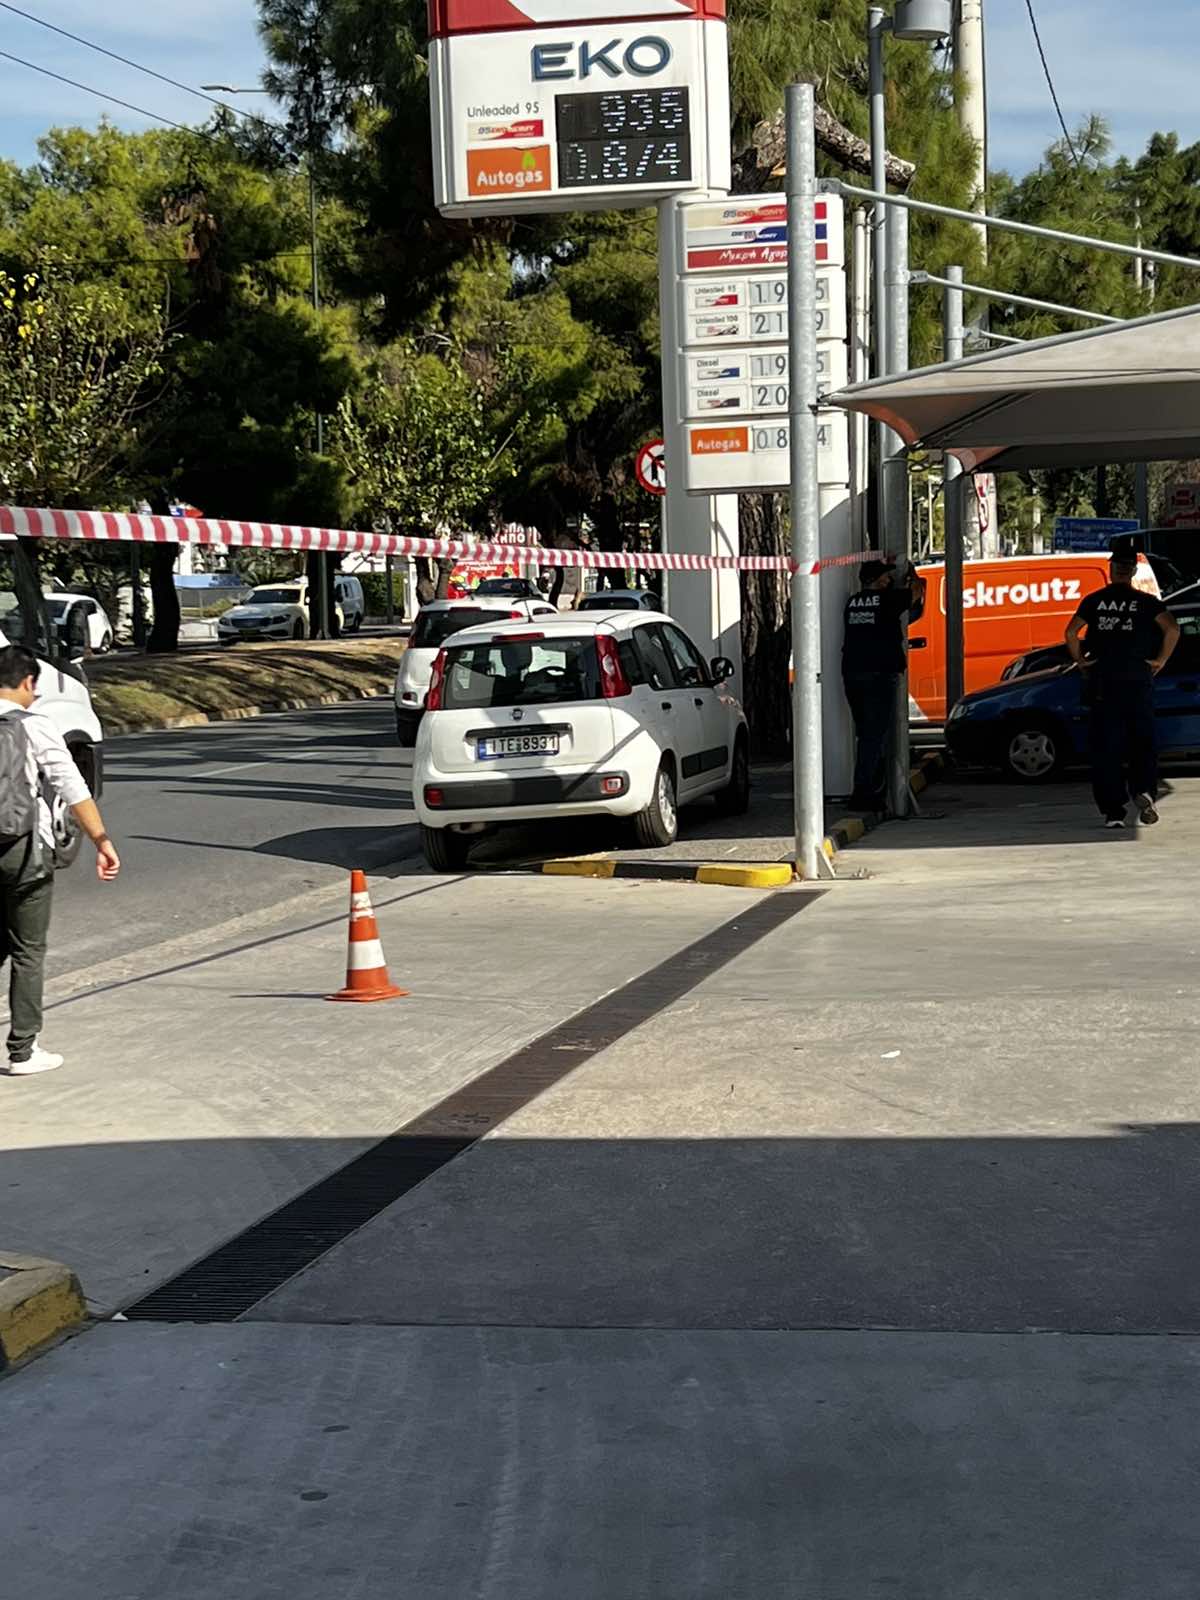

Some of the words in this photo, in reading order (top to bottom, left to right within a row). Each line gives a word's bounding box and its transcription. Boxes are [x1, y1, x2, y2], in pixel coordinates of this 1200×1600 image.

[531, 35, 672, 82] EKO
[467, 103, 520, 118] Unleaded
[525, 101, 540, 114] 95
[476, 169, 544, 188] Autogas
[760, 247, 788, 263] Αγορ
[696, 358, 719, 368] Diesel
[696, 388, 720, 398] Diesel
[696, 439, 742, 452] Autogas
[962, 577, 1081, 609] skroutz
[848, 595, 881, 608] ΑΑΔΕ
